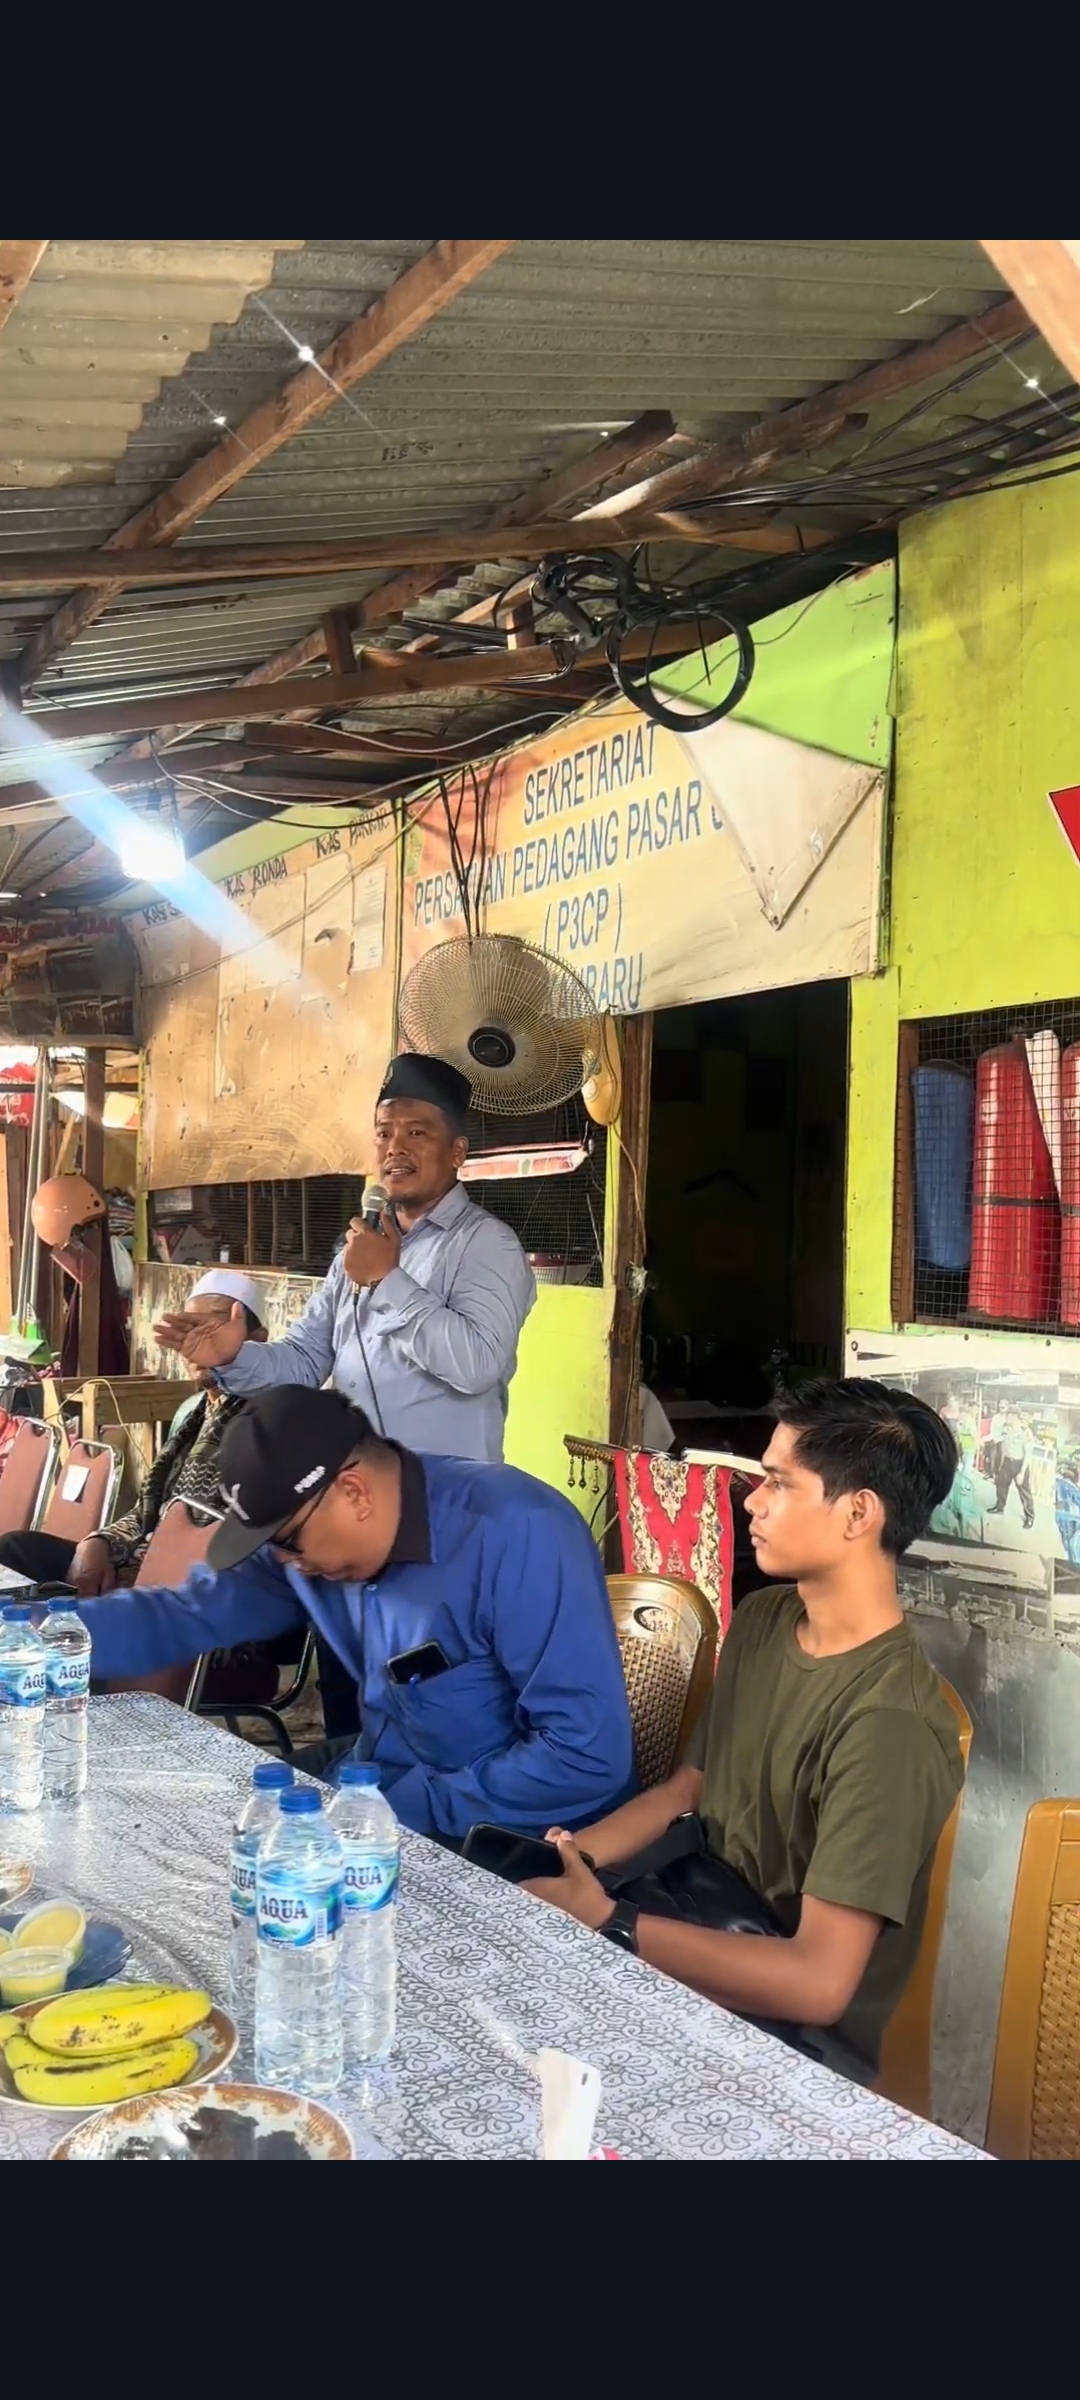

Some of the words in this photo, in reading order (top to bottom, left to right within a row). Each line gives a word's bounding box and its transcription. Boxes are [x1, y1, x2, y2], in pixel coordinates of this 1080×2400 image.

[524, 720, 661, 825] SEKRETARIAT
[316, 830, 341, 859] KAS
[511, 809, 619, 897] PEDAGANG
[626, 779, 702, 860] PASAR
[252, 856, 288, 899] RONDA
[557, 888, 609, 953] P3CP
[231, 1864, 256, 1891] QUA
[344, 1865, 383, 1891] QUA
[260, 1894, 309, 1924] AQUA
